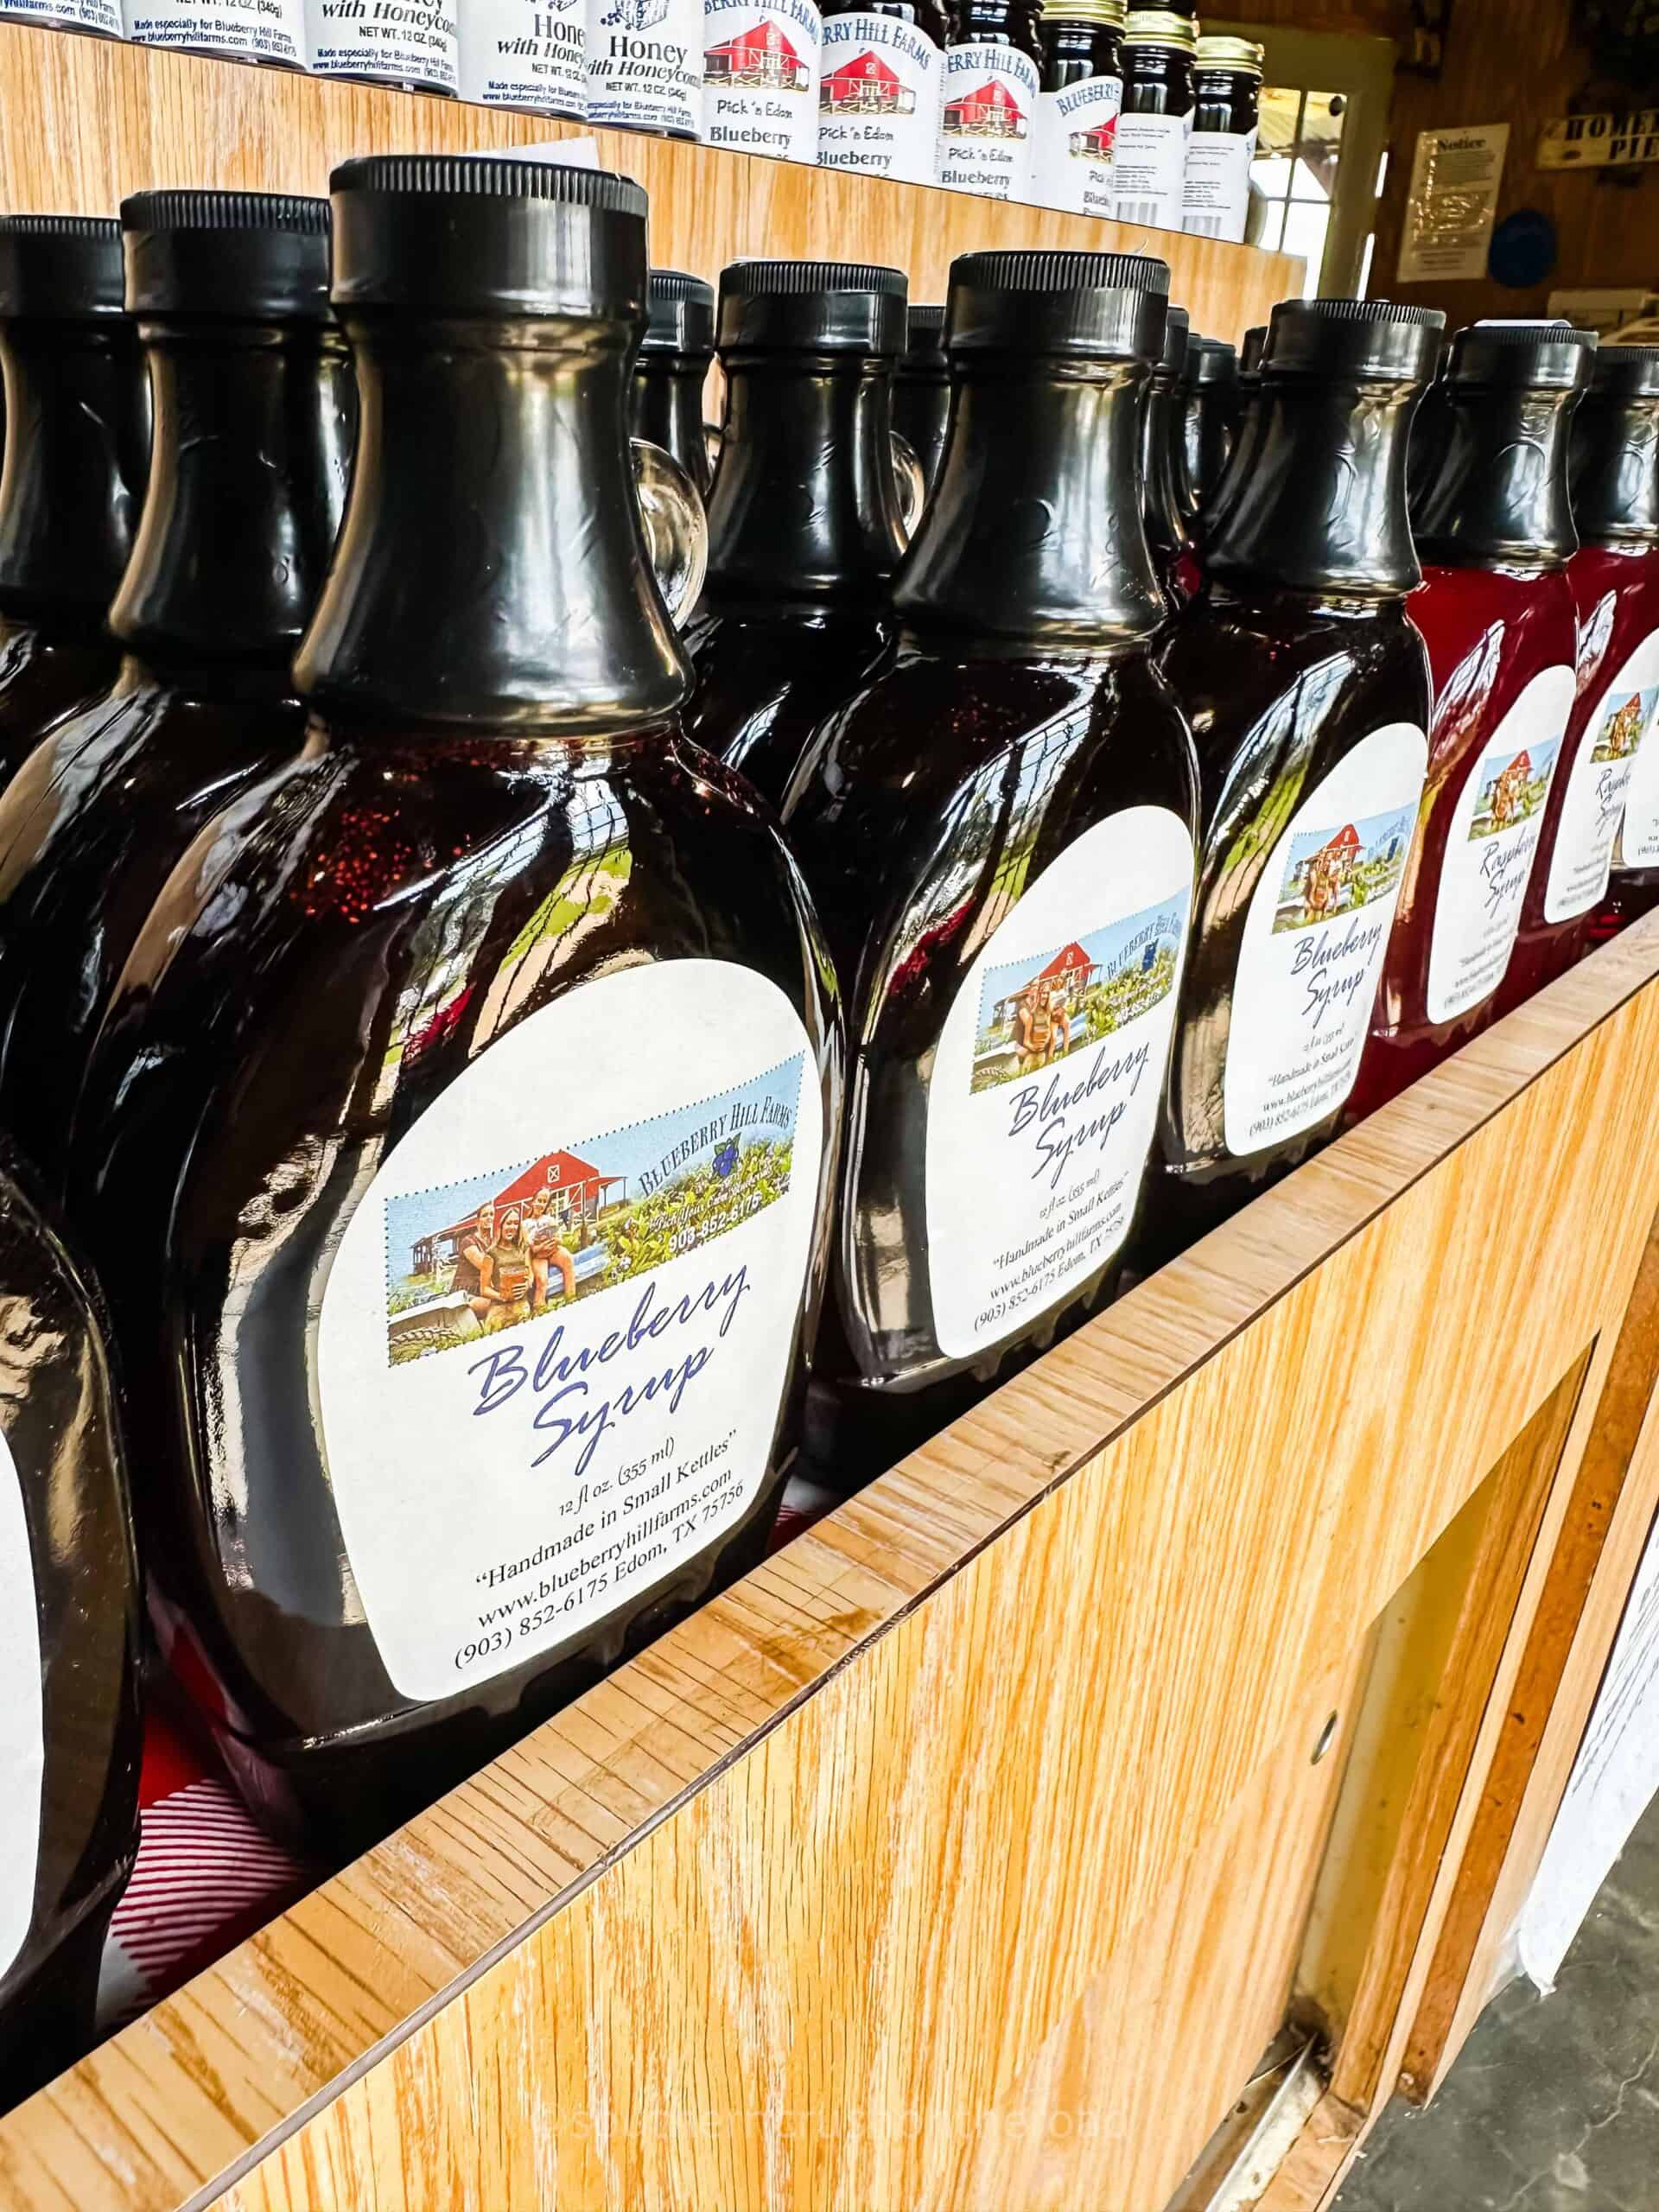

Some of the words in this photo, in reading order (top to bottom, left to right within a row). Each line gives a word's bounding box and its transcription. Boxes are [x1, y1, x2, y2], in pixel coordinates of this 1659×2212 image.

[155, 18, 197, 34] especially
[200, 20, 213, 30] for
[215, 21, 257, 36] Blueberry
[322, 1, 365, 18] with
[372, 2, 456, 37] Honeyco
[359, 26, 380, 38] NET
[381, 28, 401, 41] WT.
[534, 14, 586, 48] Hone
[338, 48, 378, 61] especially
[381, 49, 392, 59] for
[498, 37, 538, 55] with
[543, 42, 588, 70] Honey
[609, 36, 689, 69] Honey
[855, 18, 888, 44] HILL
[892, 25, 931, 70] FARMS
[606, 82, 623, 92] NET
[716, 99, 748, 114] Pick
[710, 125, 792, 149] Blueberry
[818, 125, 849, 140] Pick
[1438, 137, 1486, 151] Notice
[941, 170, 1012, 190] Blueberry
[1290, 916, 1382, 976] Blueberry
[1301, 968, 1363, 1029] Syrup
[1008, 1041, 1150, 1137] Blueberry
[639, 1114, 728, 1198] BLUEBERRY
[729, 1102, 759, 1131] HILL
[760, 1095, 792, 1130] FARMS
[1031, 1100, 1127, 1190] Syrup
[669, 1192, 763, 1252] 903-852-6175
[1056, 1219, 1065, 1234] in
[1067, 1196, 1095, 1225] Small
[974, 1302, 1007, 1333] (903)
[467, 1265, 751, 1416] Blueberry
[531, 1346, 715, 1476] Syrup
[558, 1500, 573, 1516] 12
[573, 1484, 588, 1515] fl
[593, 1479, 613, 1500] oz.
[618, 1458, 647, 1486] (355
[650, 1437, 675, 1466] ml)
[476, 1522, 594, 1590] “Handmade
[601, 1509, 618, 1530] in
[623, 1471, 671, 1516] Small
[676, 1428, 737, 1484] Kettles”
[477, 1467, 732, 1629] www.blueberryhillfarms.com
[454, 1628, 513, 1669] (903)
[519, 1573, 608, 1637] 852-6175
[613, 1541, 668, 1584] Edom,
[671, 1515, 698, 1545] TX
[702, 1479, 745, 1524] 75756
